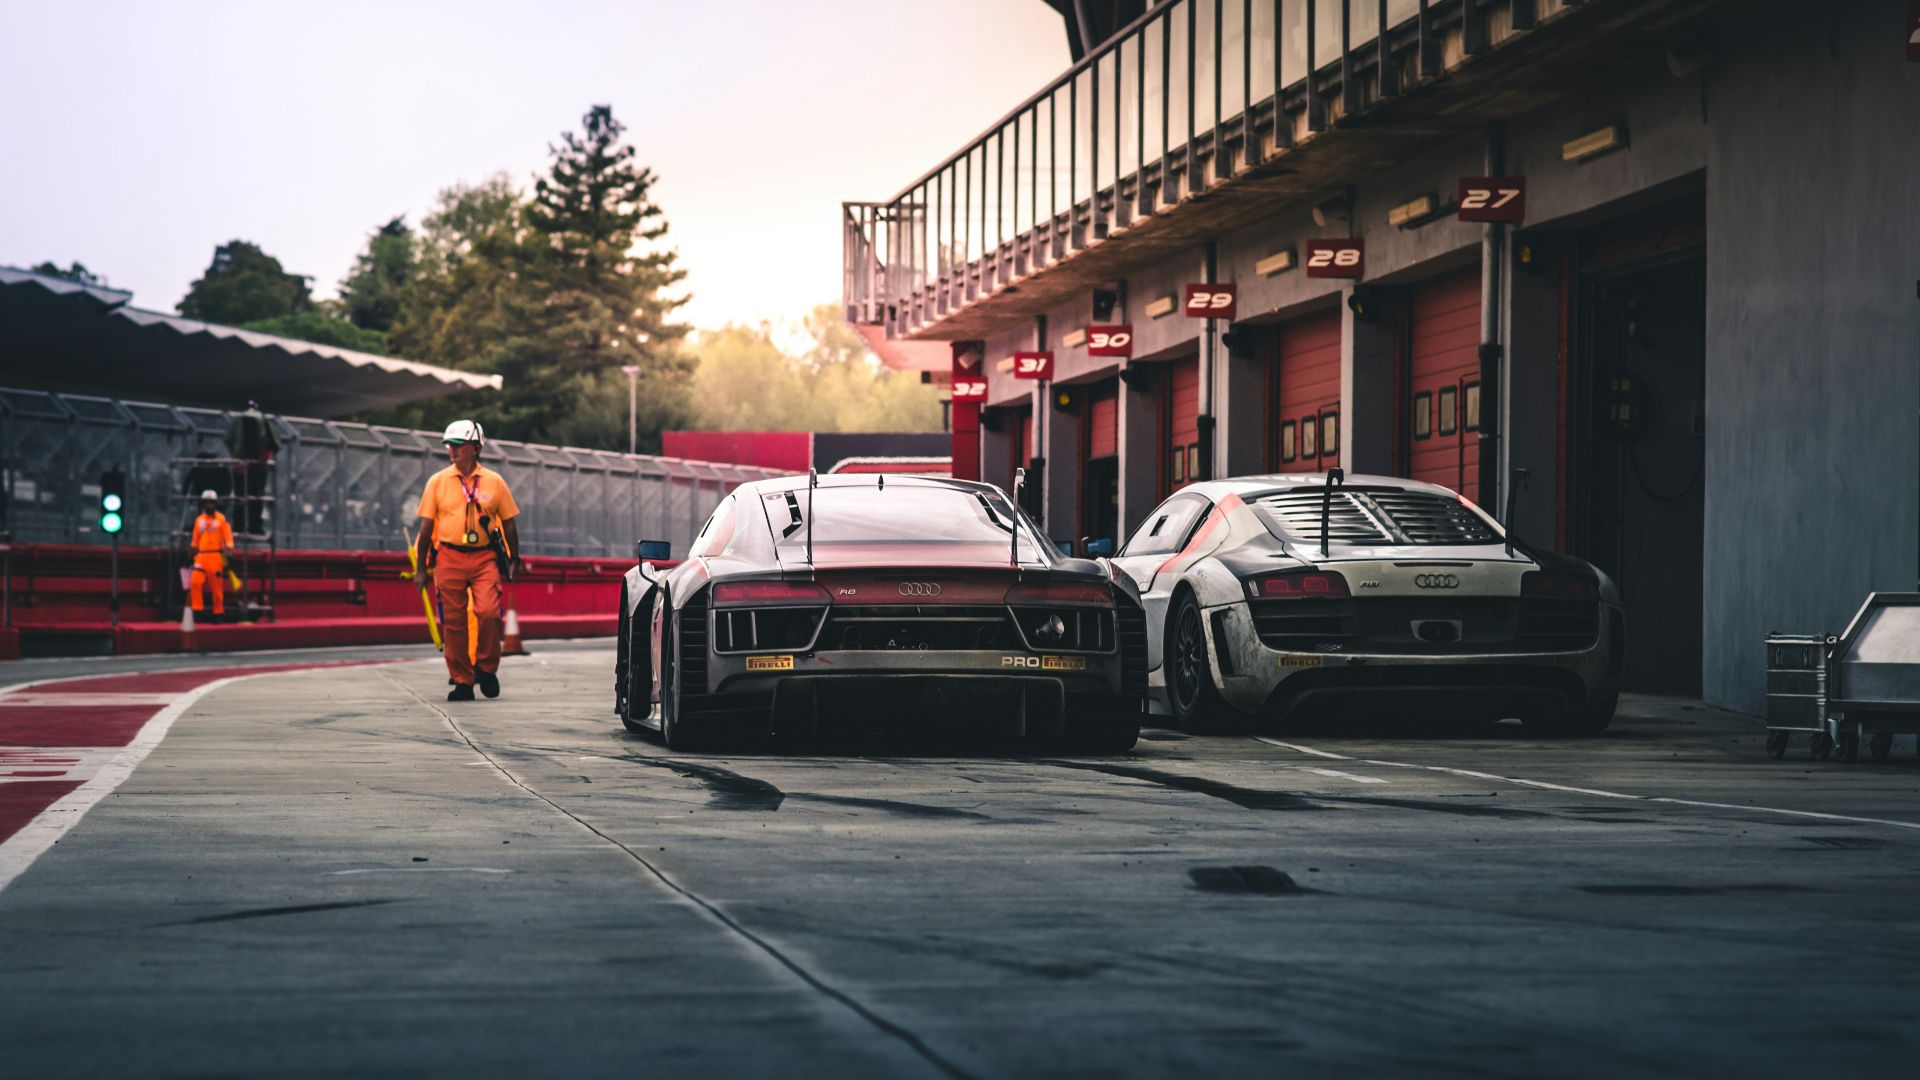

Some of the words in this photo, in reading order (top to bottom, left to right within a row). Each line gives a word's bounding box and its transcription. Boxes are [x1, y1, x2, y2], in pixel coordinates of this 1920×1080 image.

[1460, 189, 1520, 209] 27
[1308, 249, 1361, 267] 28
[1187, 292, 1233, 309] 29
[1089, 332, 1131, 348] 30
[1018, 358, 1047, 373] 31
[953, 382, 987, 396] 32
[747, 657, 792, 669] PIRELLI
[1001, 656, 1040, 667] PRO
